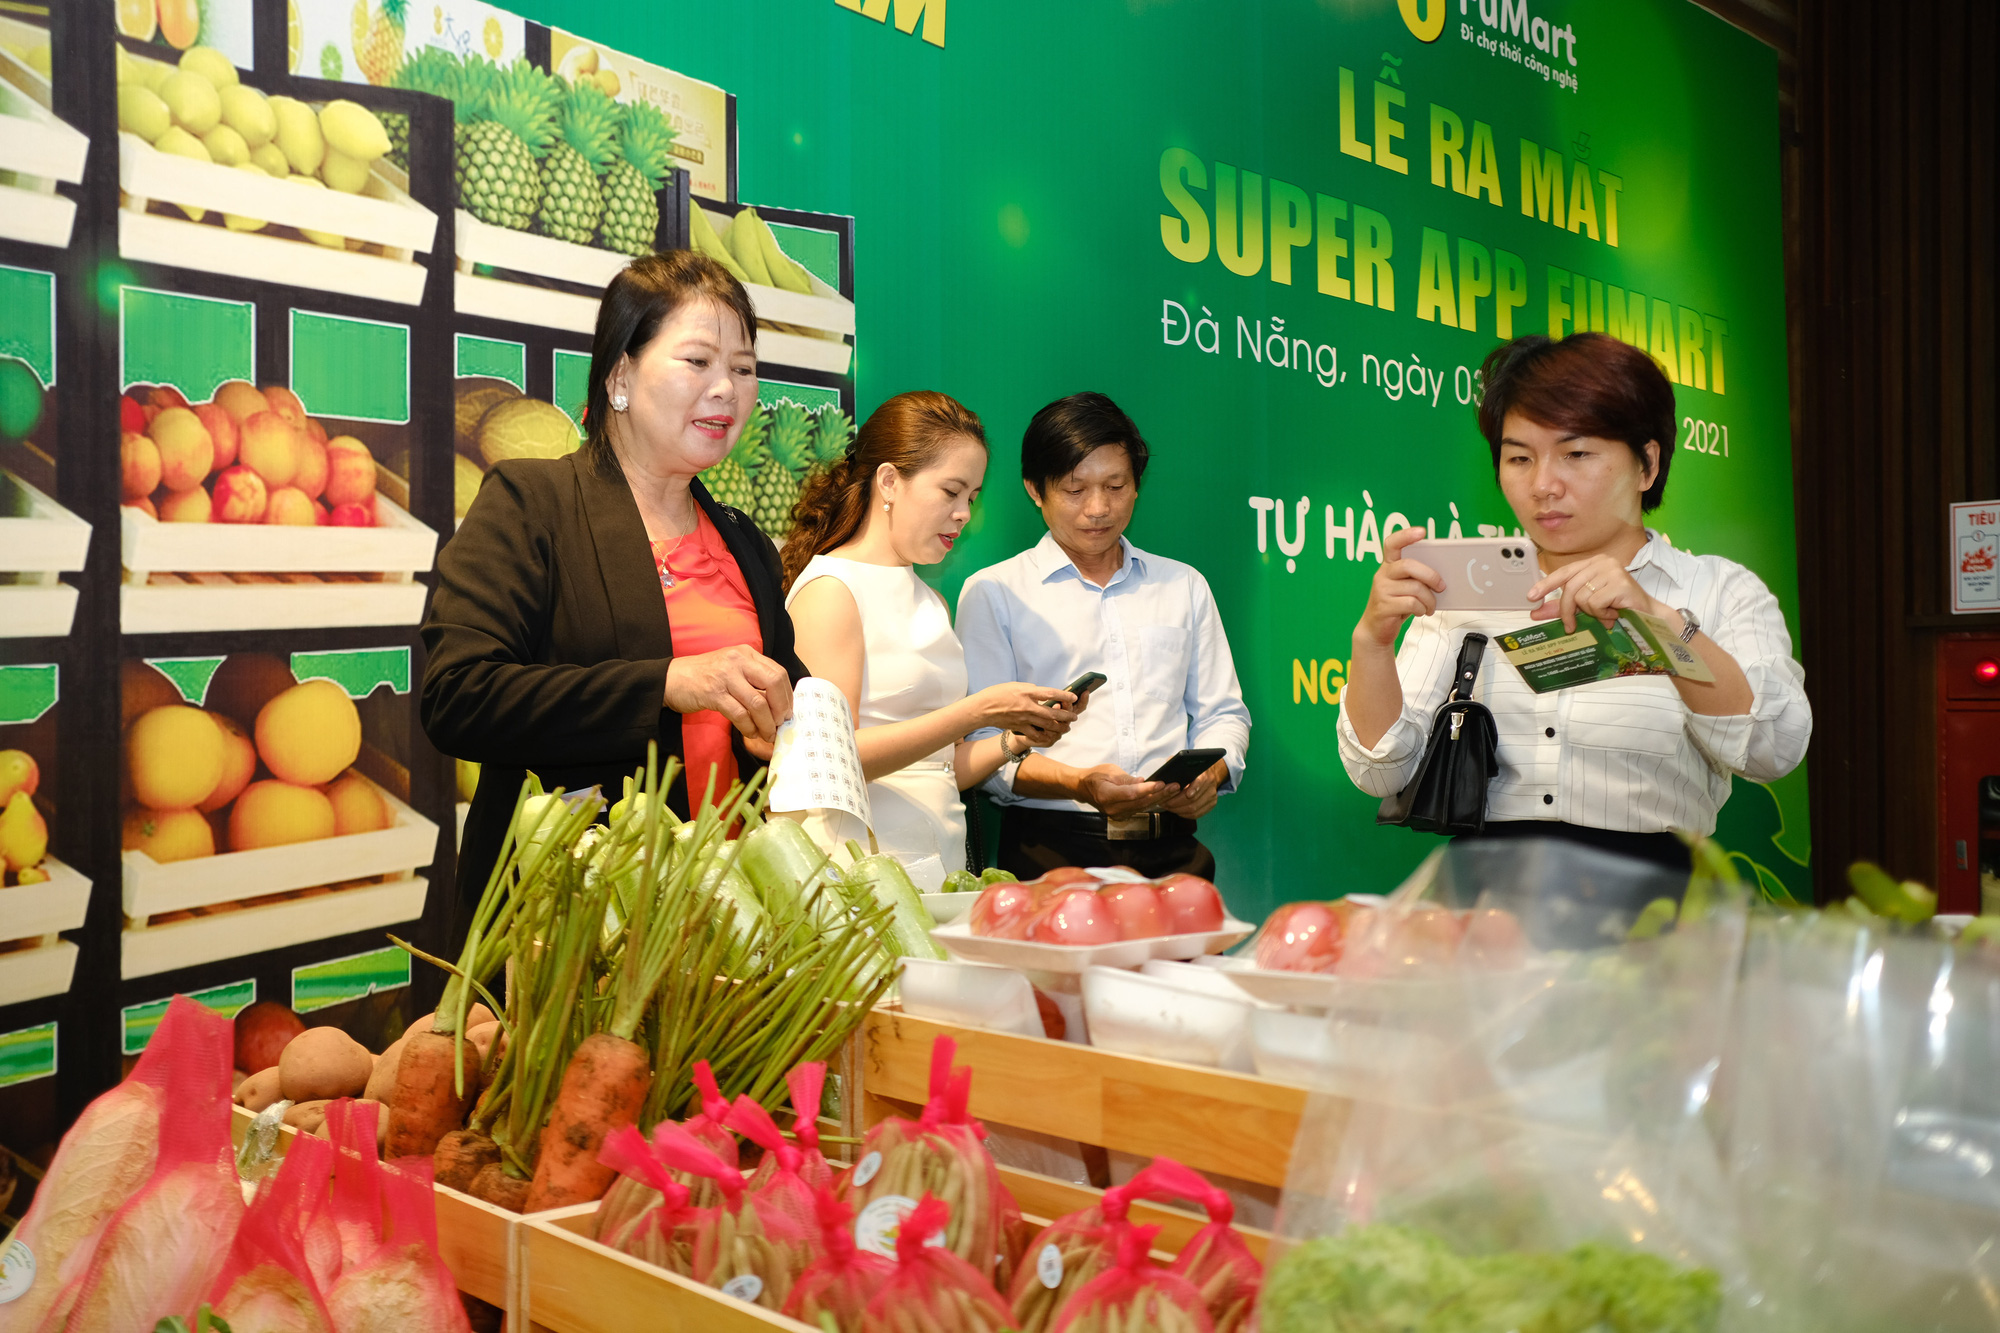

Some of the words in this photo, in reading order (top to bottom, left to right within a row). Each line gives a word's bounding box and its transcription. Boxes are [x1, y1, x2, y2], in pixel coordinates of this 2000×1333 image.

[1460, 23, 1474, 43] Đi
[1477, 31, 1498, 57] chợ
[1500, 41, 1522, 64] thời
[1524, 53, 1550, 82] công
[1552, 69, 1578, 94] nghệ
[1339, 51, 1408, 176] LỄ
[1430, 102, 1503, 207] RA
[1159, 146, 1396, 312] SUPER
[1416, 225, 1528, 341] APP
[1547, 264, 1729, 396] FUMART
[1161, 299, 1219, 354] Đà
[1237, 315, 1347, 388] Nẵng,
[1362, 353, 1444, 408] ngày
[1683, 416, 1729, 458] 2021
[1249, 495, 1310, 574] TỰ
[1517, 631, 1546, 644] FuMart
[1293, 658, 1351, 705] NG
